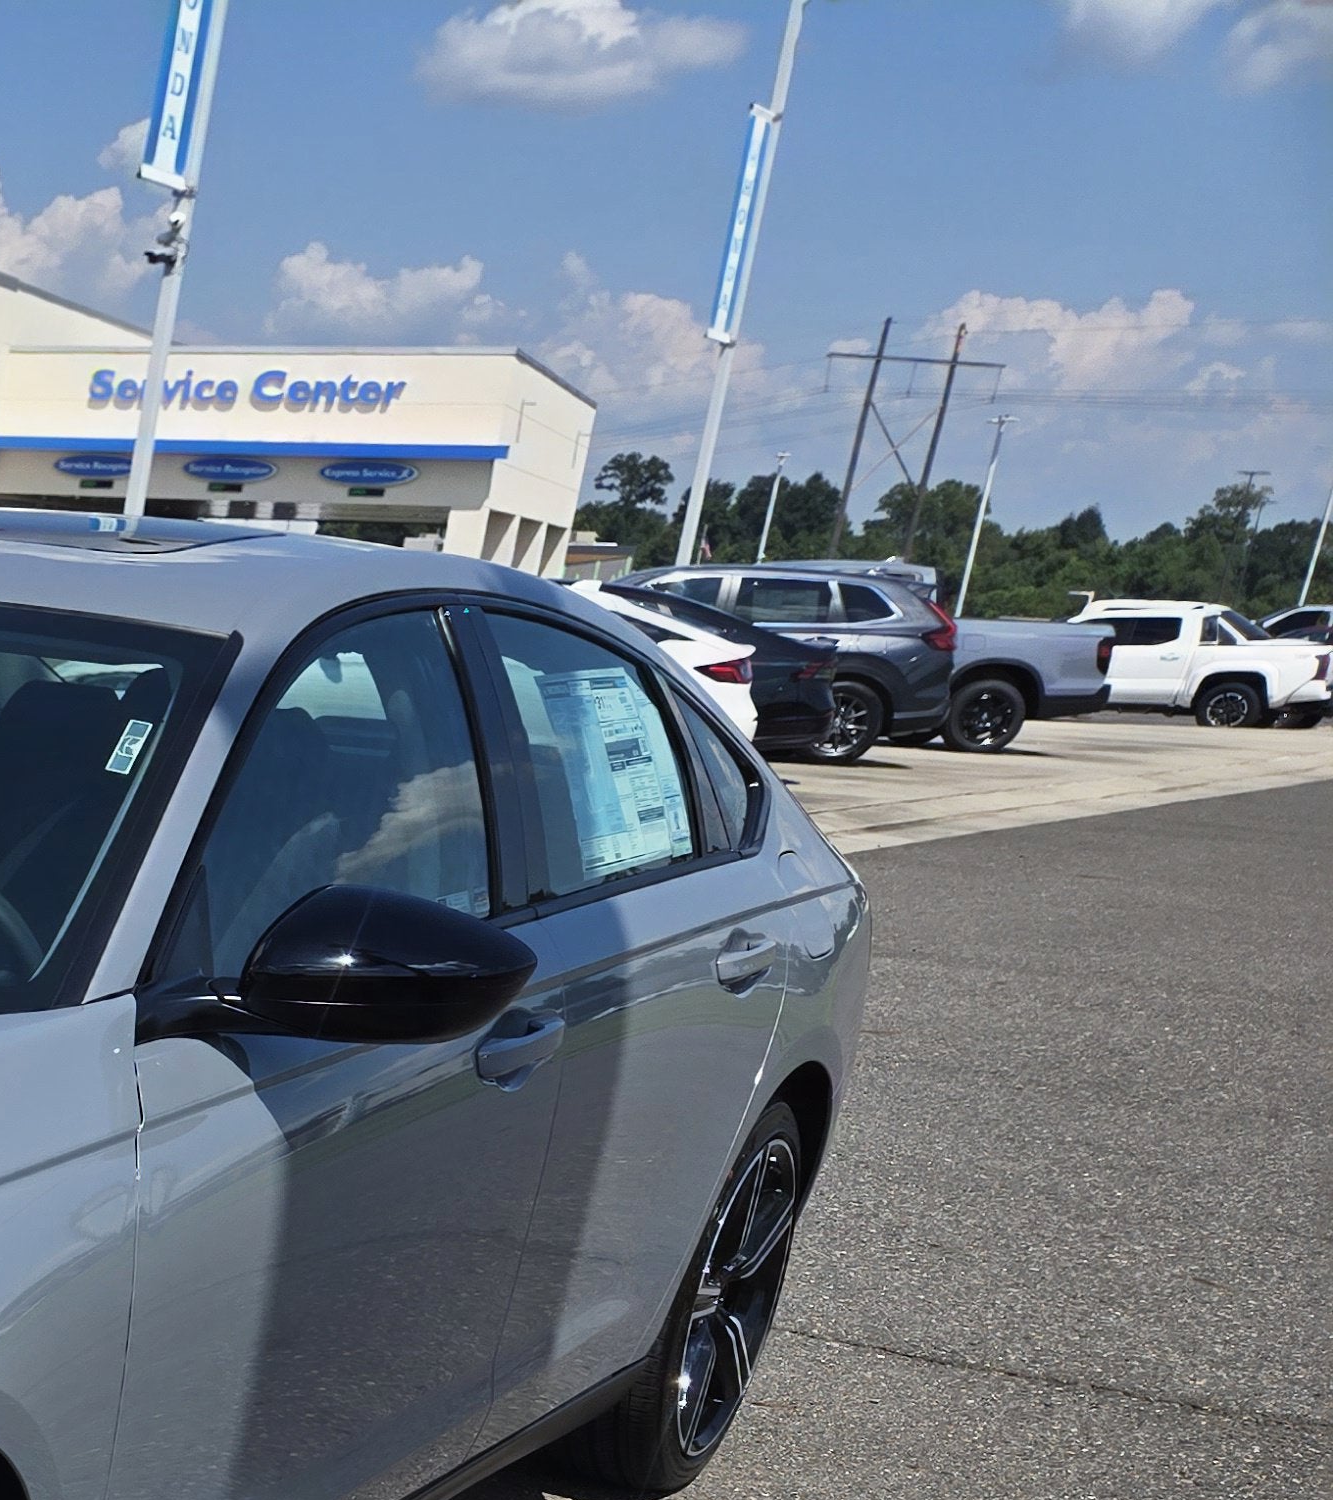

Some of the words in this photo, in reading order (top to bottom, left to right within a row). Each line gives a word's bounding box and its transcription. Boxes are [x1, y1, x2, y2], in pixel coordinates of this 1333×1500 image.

[89, 369, 239, 411] Sevice
[250, 369, 407, 413] Center
[59, 461, 91, 471] Service
[189, 464, 222, 473] Service
[223, 464, 271, 475] Reception
[362, 467, 397, 478] Service
